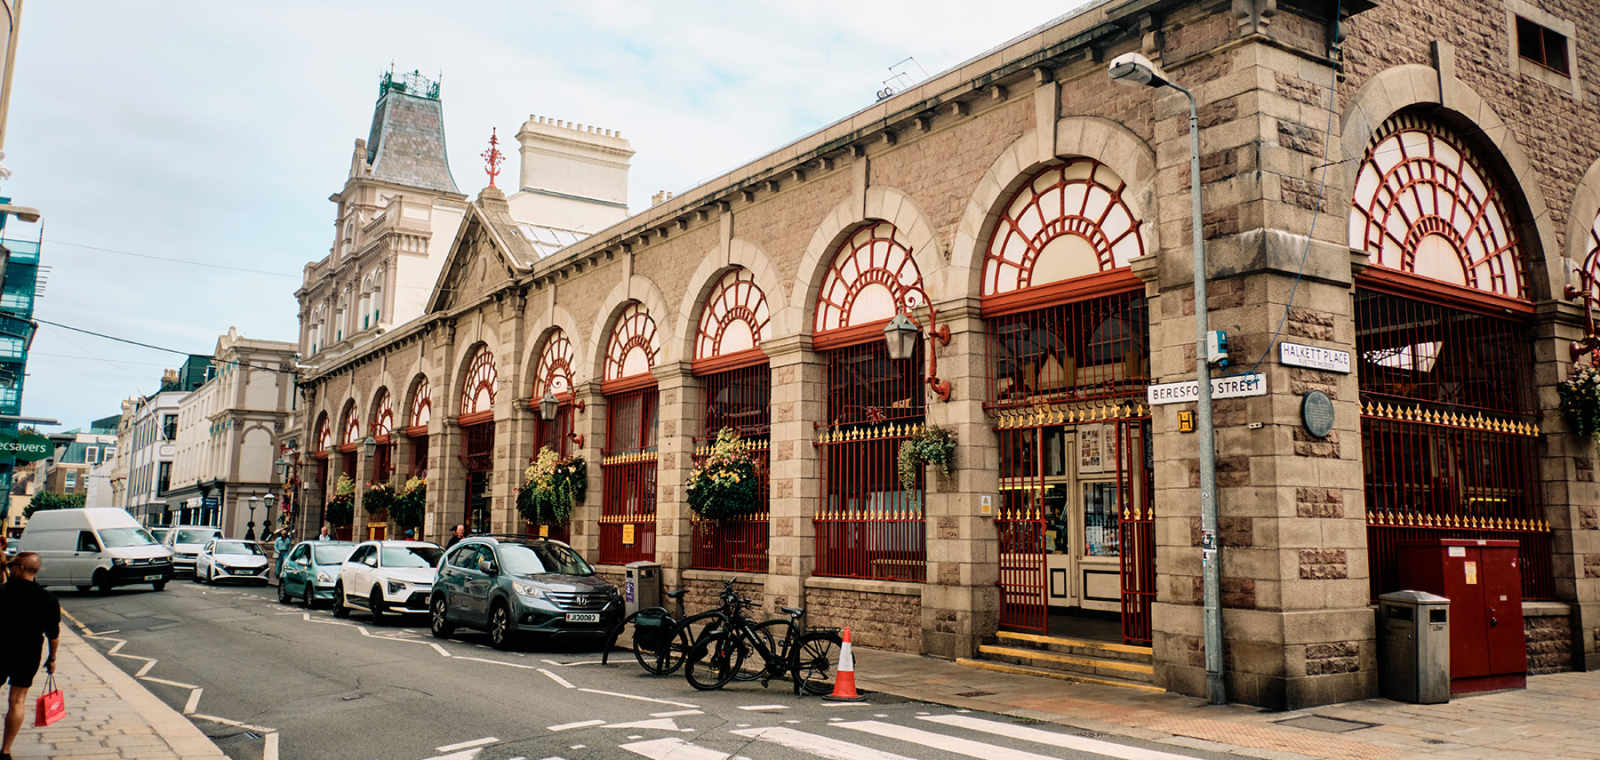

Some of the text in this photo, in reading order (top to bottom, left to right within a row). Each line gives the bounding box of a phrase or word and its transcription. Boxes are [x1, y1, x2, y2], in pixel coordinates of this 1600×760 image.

[1284, 344, 1321, 360] HALKETT
[1324, 351, 1348, 365] PLACE
[1153, 380, 1259, 400] BERESFOD STREET
